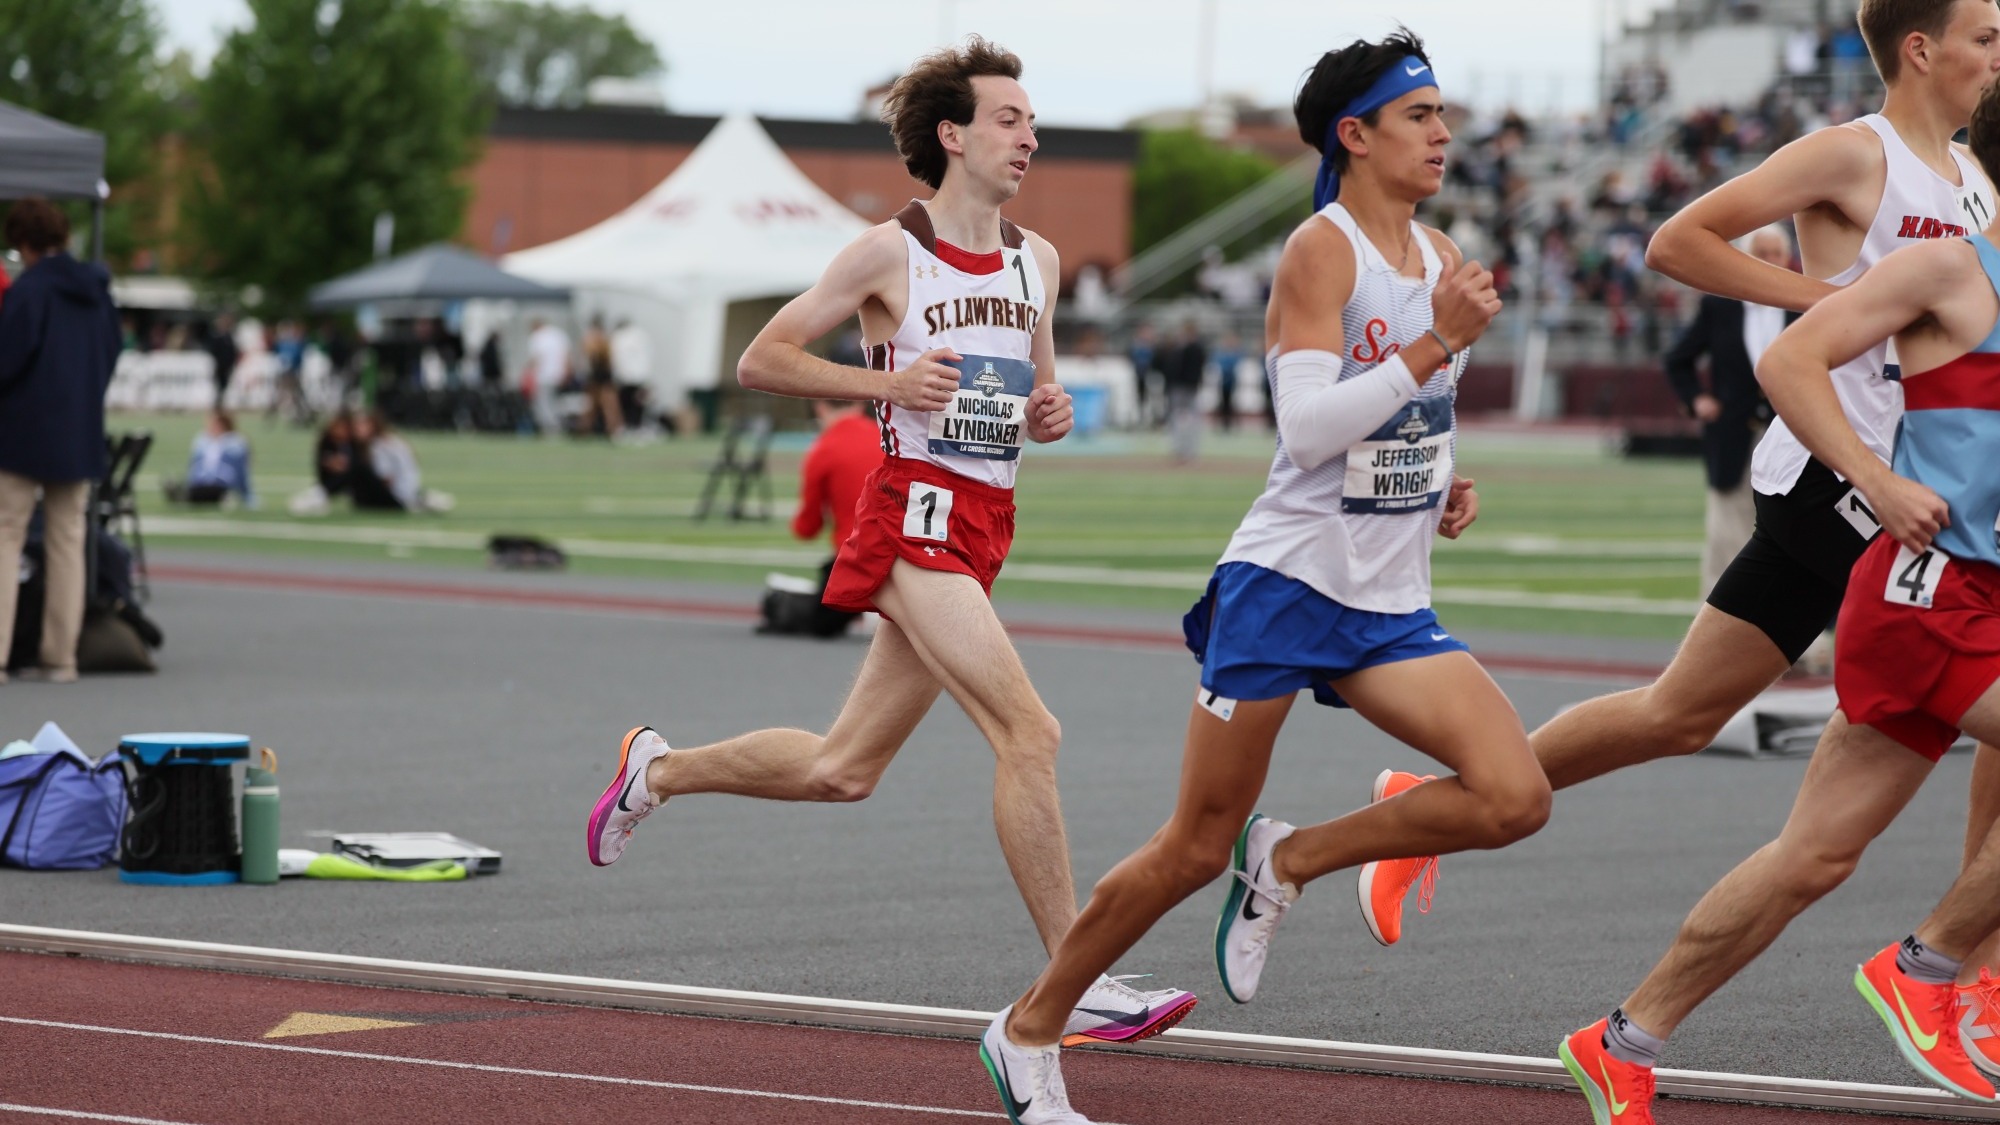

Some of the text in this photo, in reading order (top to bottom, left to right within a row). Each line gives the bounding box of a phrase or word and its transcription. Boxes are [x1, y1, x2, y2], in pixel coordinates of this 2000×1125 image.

[1011, 254, 1030, 301] 1
[924, 301, 952, 336] ST.
[958, 397, 1014, 419] NICHOLAS
[1371, 444, 1440, 468] JEFFERSON
[1373, 468, 1434, 496] WRIGHT
[920, 490, 938, 535] 1
[1896, 550, 1935, 602] 4
